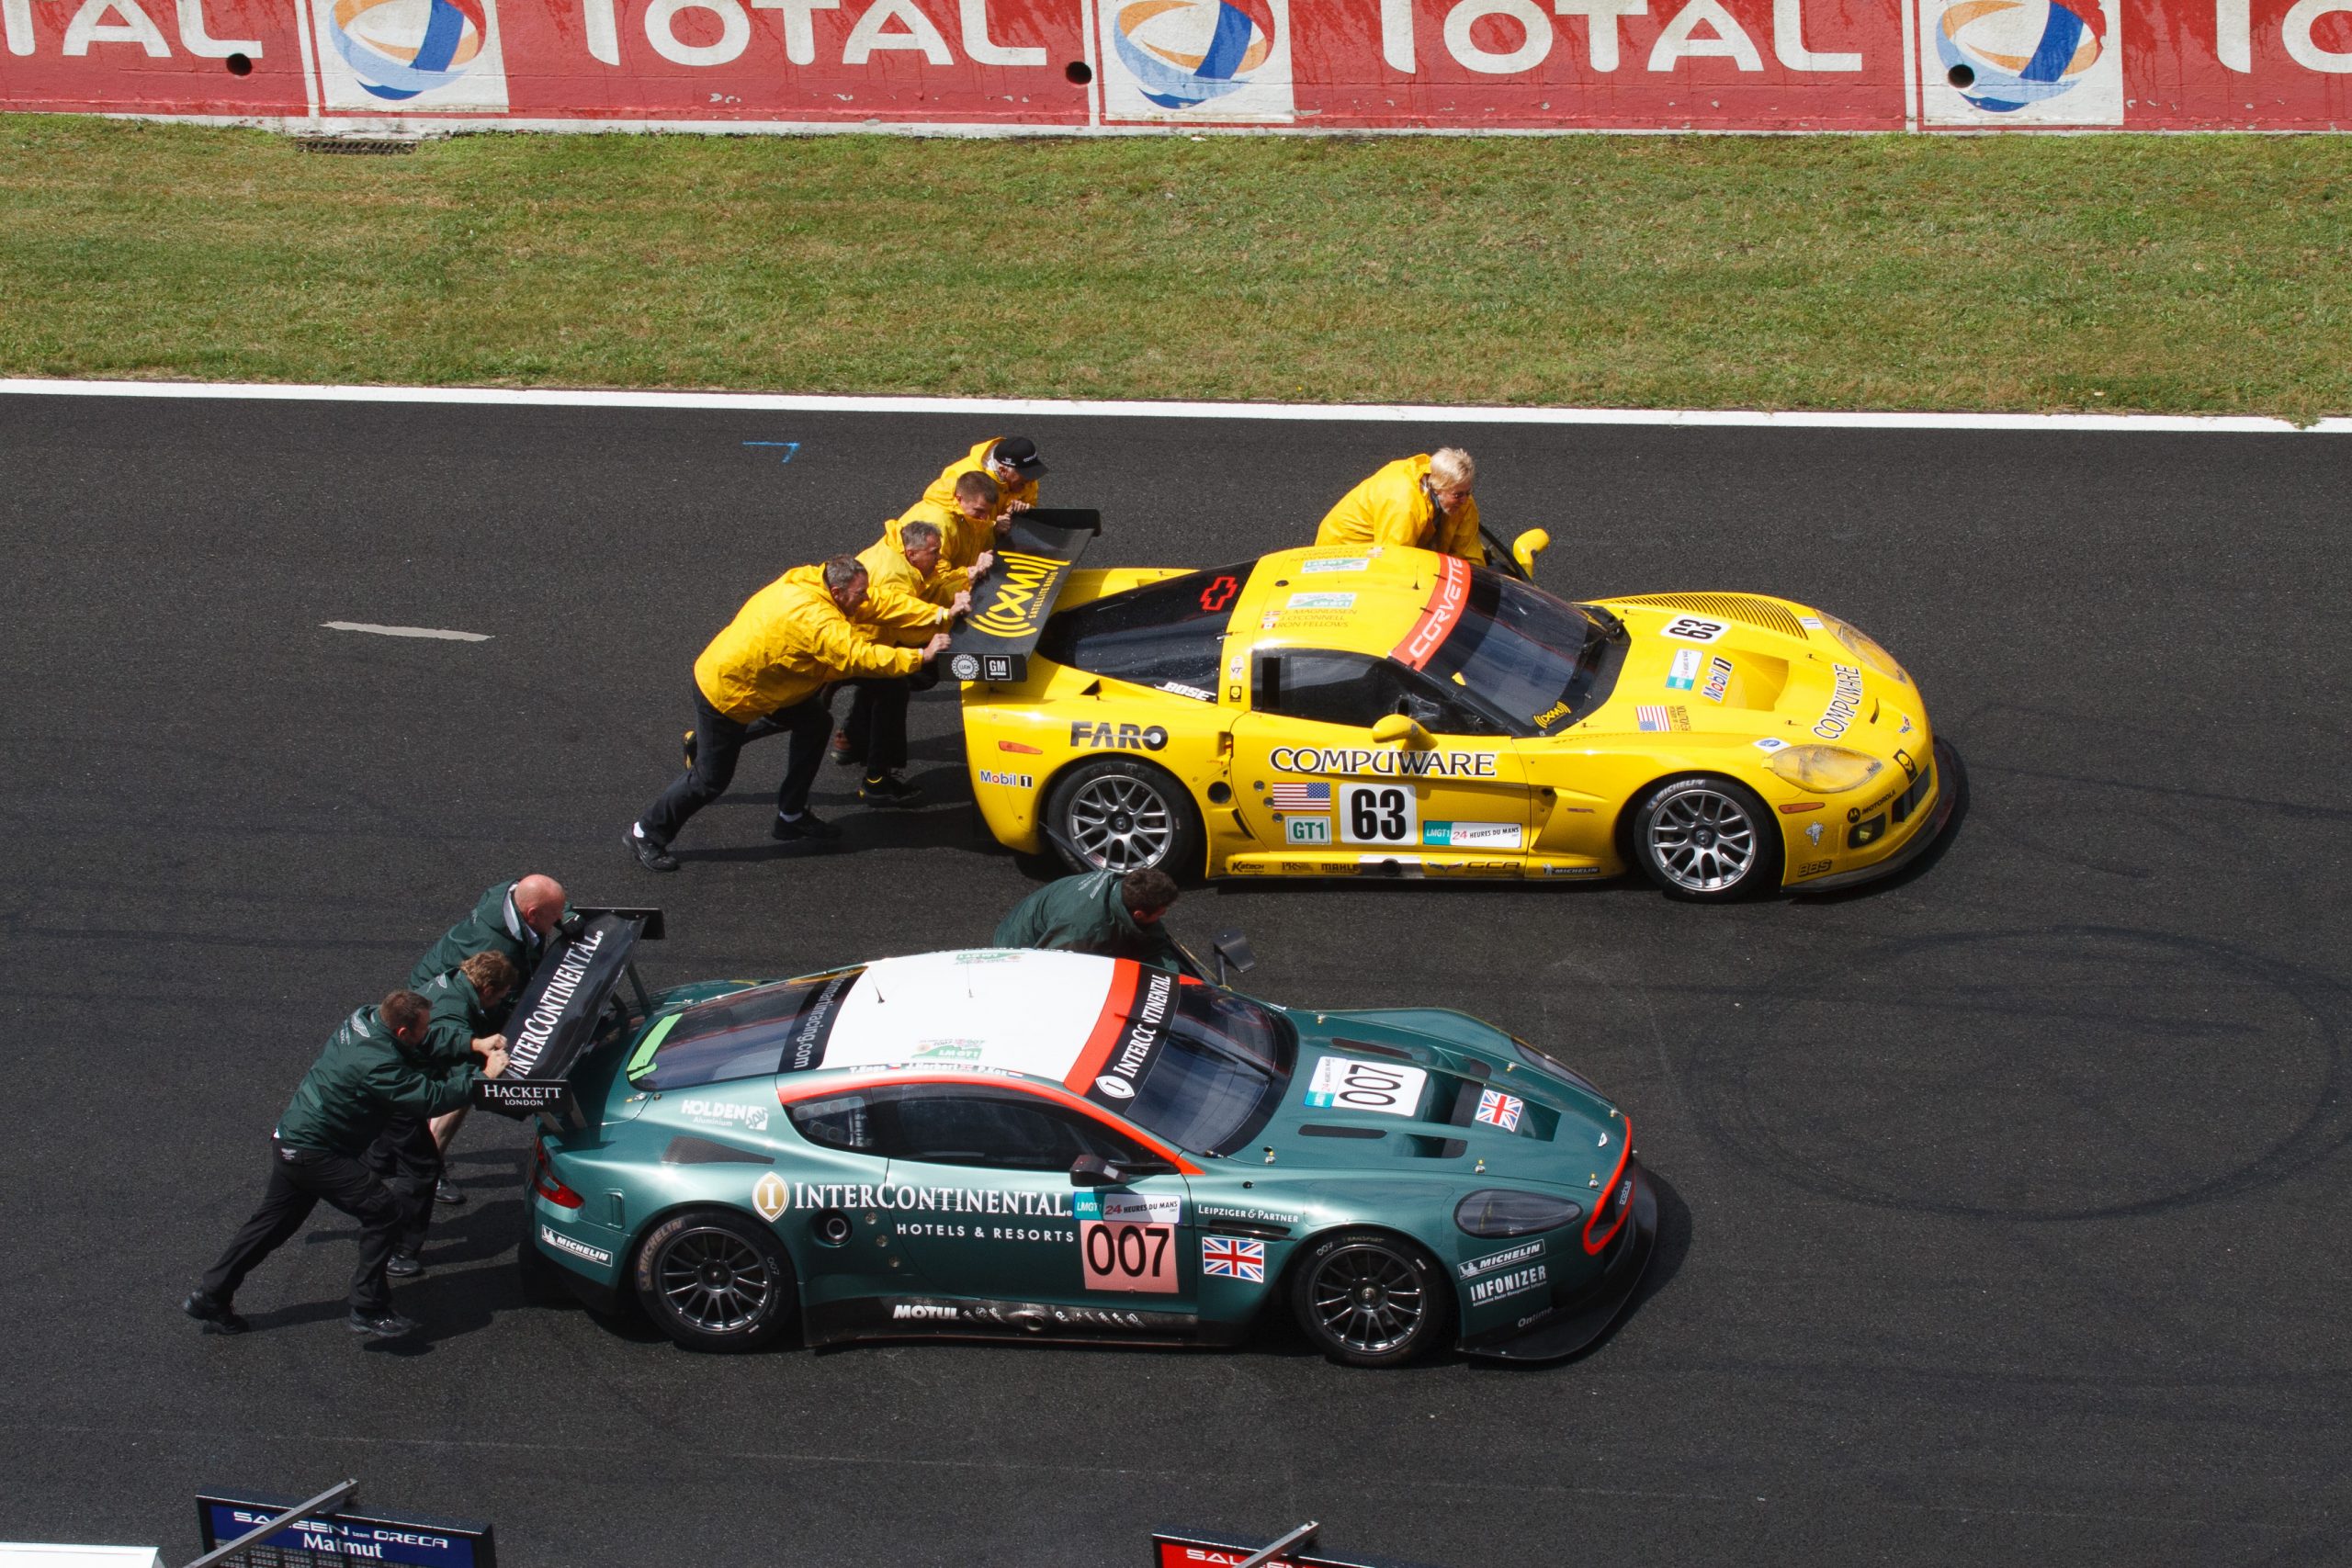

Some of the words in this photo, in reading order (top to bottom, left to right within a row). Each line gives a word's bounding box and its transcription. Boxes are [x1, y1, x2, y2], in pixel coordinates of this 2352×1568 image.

[1408, 555, 1464, 659] CORVETTE
[1668, 618, 1722, 640] 63
[989, 660, 1006, 671] GM
[1713, 657, 1733, 671] 1
[1156, 681, 1216, 701] BOSE
[1702, 669, 1729, 702] Mobil
[1814, 664, 1860, 739] COMPUWARE
[1069, 721, 1169, 751] FARO
[1271, 748, 1496, 776] COMPUWARE
[980, 771, 1016, 786] Mobil
[1021, 775, 1033, 787] 1
[1351, 788, 1407, 840] 63
[1292, 821, 1326, 840] GT1
[1426, 829, 1450, 838] LMGT1
[1452, 829, 1468, 840] 24
[1469, 830, 1490, 839] HEURES
[1797, 859, 1832, 877] BBS
[483, 1084, 561, 1099] HACKETT
[1339, 1065, 1404, 1106] 007
[505, 1097, 544, 1106] LONDON
[682, 1100, 747, 1120] HOLDEN
[693, 1116, 733, 1127] Aluminium
[795, 1181, 1068, 1217] INTERCONTINENTAL
[1104, 1204, 1123, 1215] 24
[1124, 1203, 1148, 1213] HEURES
[1148, 1202, 1158, 1211] DU
[1159, 1201, 1178, 1209] MANS
[1248, 1209, 1256, 1219] &
[897, 1224, 966, 1237] HOTELS
[974, 1225, 985, 1238] &
[993, 1227, 1074, 1242] RESORTS
[557, 1235, 609, 1261] MICHELIN
[1087, 1224, 1170, 1278] 007
[1316, 1241, 1333, 1257] 007
[1480, 1244, 1541, 1269] MICHELIN
[766, 1257, 779, 1276] 007
[1470, 1265, 1547, 1302] INFONIZER
[893, 1304, 959, 1320] MOTUL
[233, 1511, 348, 1536] SAEEN
[373, 1529, 448, 1549] ORECA
[303, 1532, 383, 1559] Matmut
